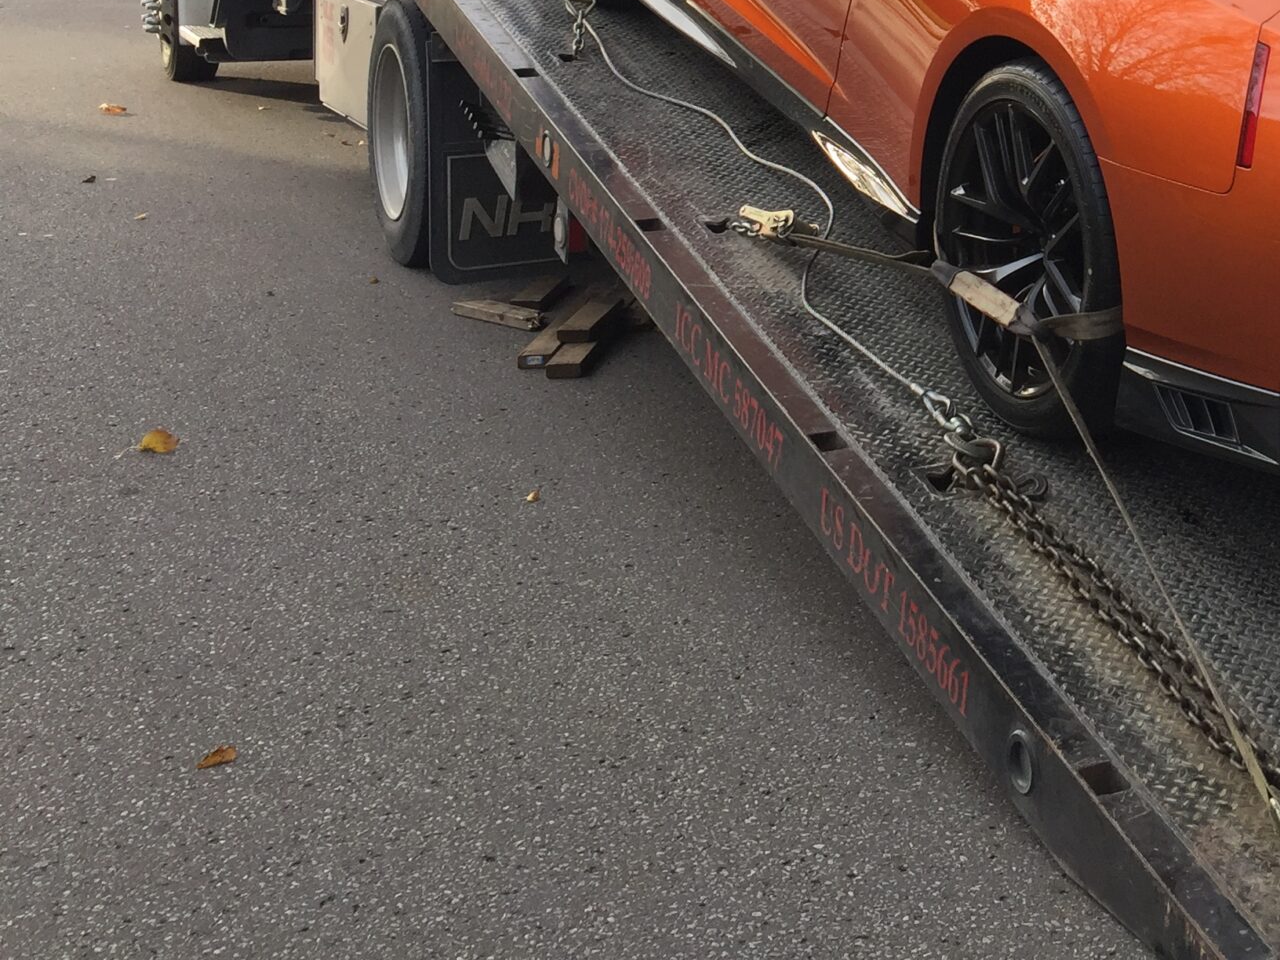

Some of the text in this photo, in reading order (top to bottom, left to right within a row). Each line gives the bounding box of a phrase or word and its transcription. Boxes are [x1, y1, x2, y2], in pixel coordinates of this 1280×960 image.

[704, 338, 731, 404] MC
[733, 377, 784, 471] 587047
[899, 591, 969, 717] 1585661
